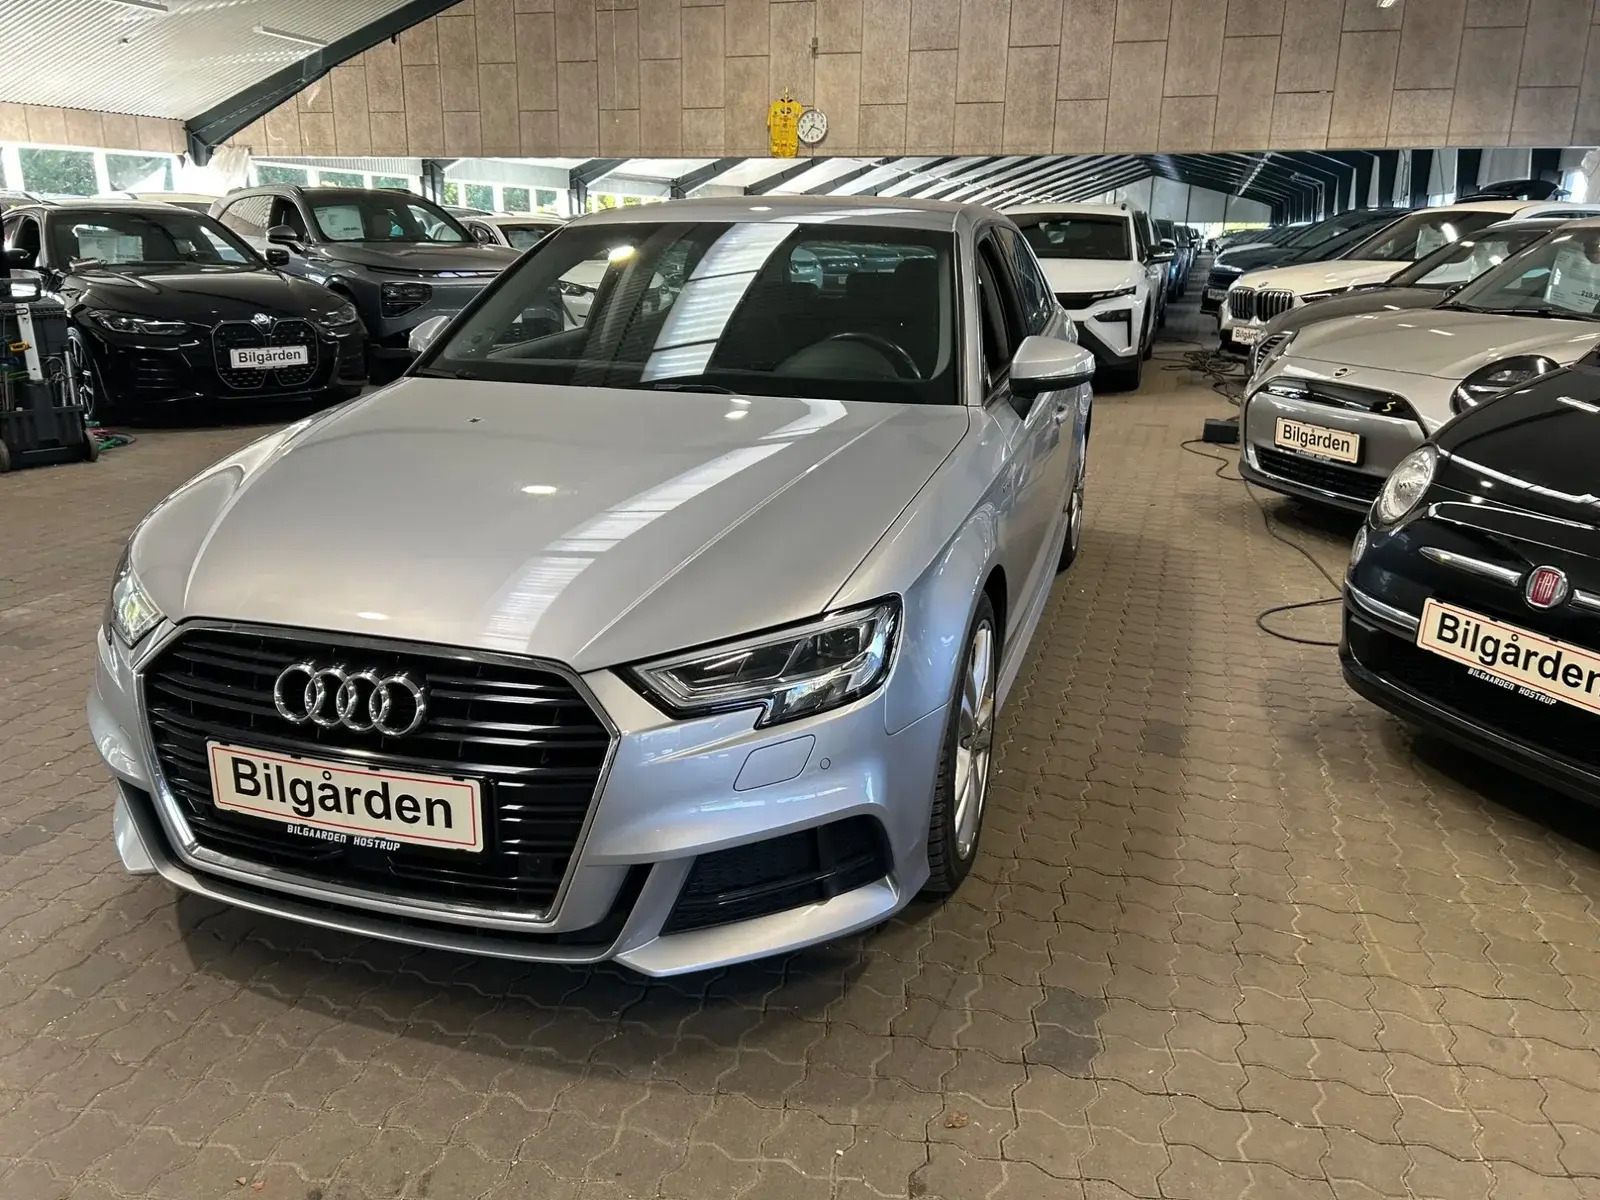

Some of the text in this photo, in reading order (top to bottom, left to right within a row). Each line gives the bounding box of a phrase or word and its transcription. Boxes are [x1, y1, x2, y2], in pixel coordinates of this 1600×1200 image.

[238, 350, 301, 364] Bilgården
[1283, 424, 1350, 453] Bilgården
[1534, 571, 1559, 602] FIAT
[1467, 667, 1515, 691] BILGAARDEN
[231, 756, 453, 829] Bilgården
[287, 823, 347, 844] BILGAARDEN
